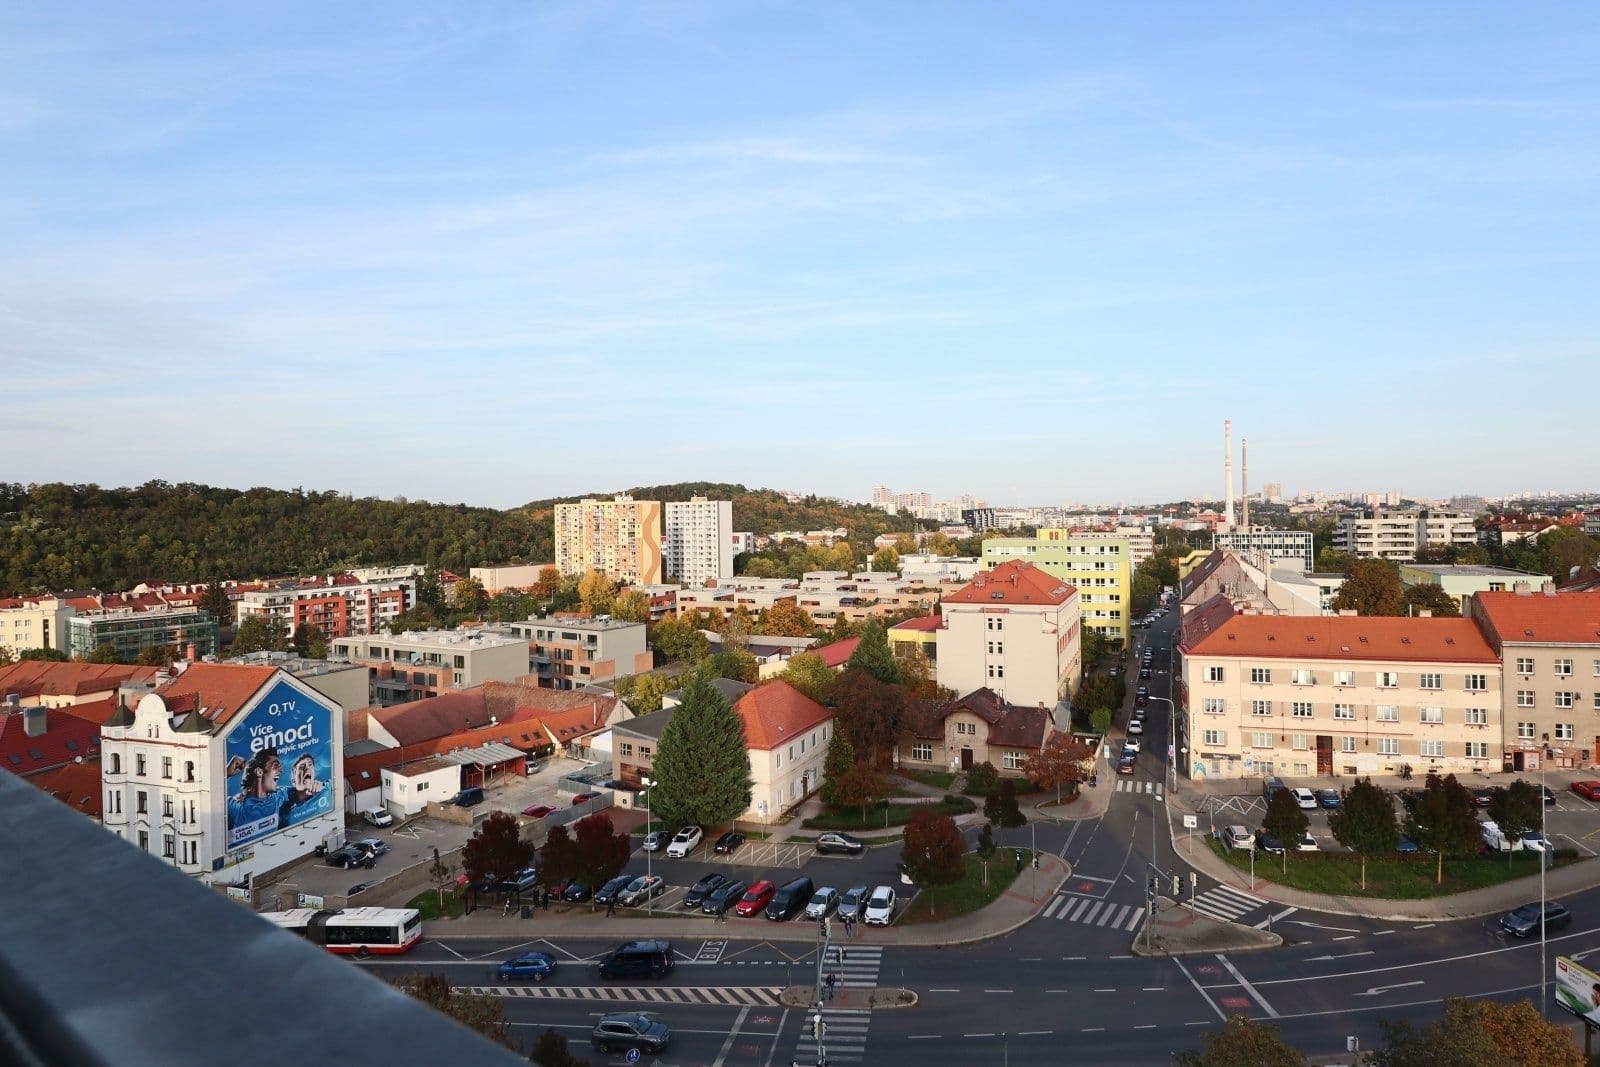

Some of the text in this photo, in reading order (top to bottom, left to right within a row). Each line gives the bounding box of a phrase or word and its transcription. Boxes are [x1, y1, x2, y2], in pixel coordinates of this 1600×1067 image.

[282, 700, 296, 712] TV
[249, 724, 273, 738] Více
[250, 716, 314, 754] emocí
[276, 737, 320, 755] nejvíc sportu
[699, 941, 723, 959] BUS
